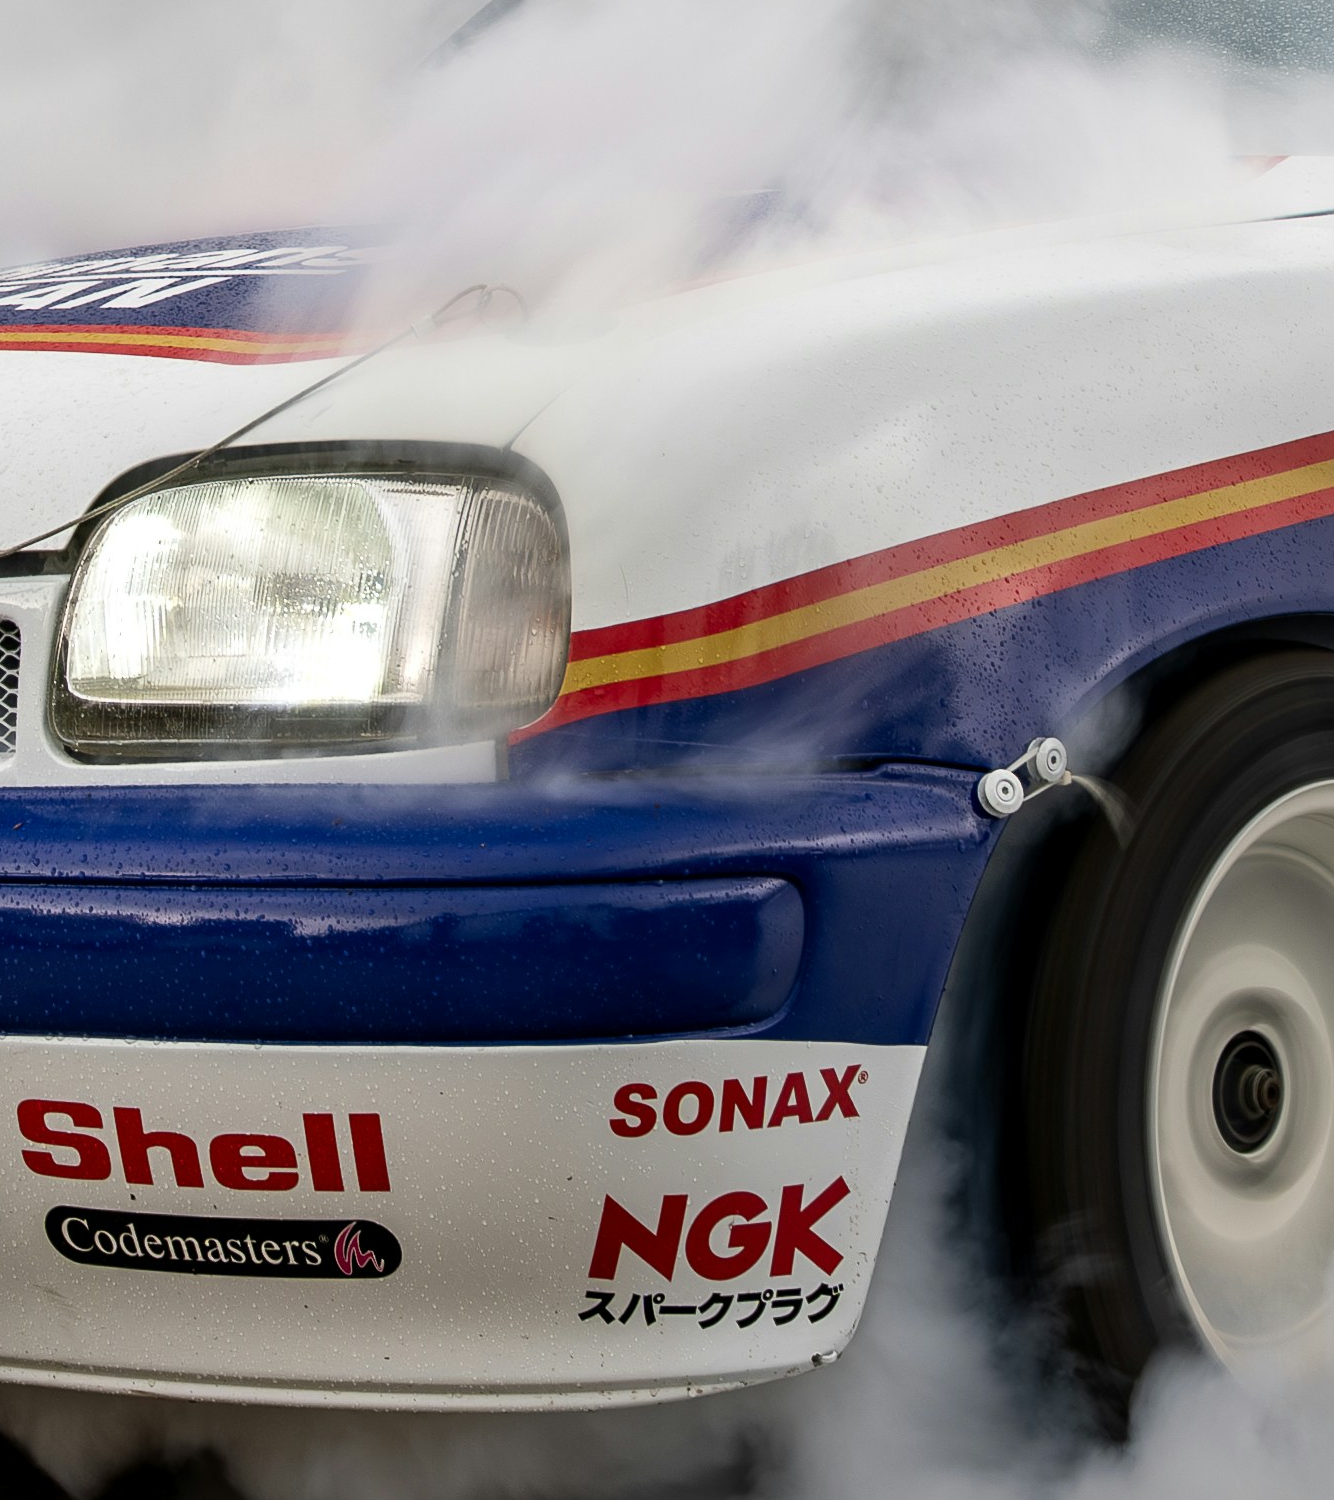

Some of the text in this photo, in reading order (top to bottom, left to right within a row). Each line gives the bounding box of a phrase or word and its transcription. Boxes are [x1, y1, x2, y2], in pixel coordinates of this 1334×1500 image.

[16, 1098, 391, 1192] Shell
[587, 1175, 851, 1283] NGK
[578, 1283, 845, 1330] スパークプラグ
